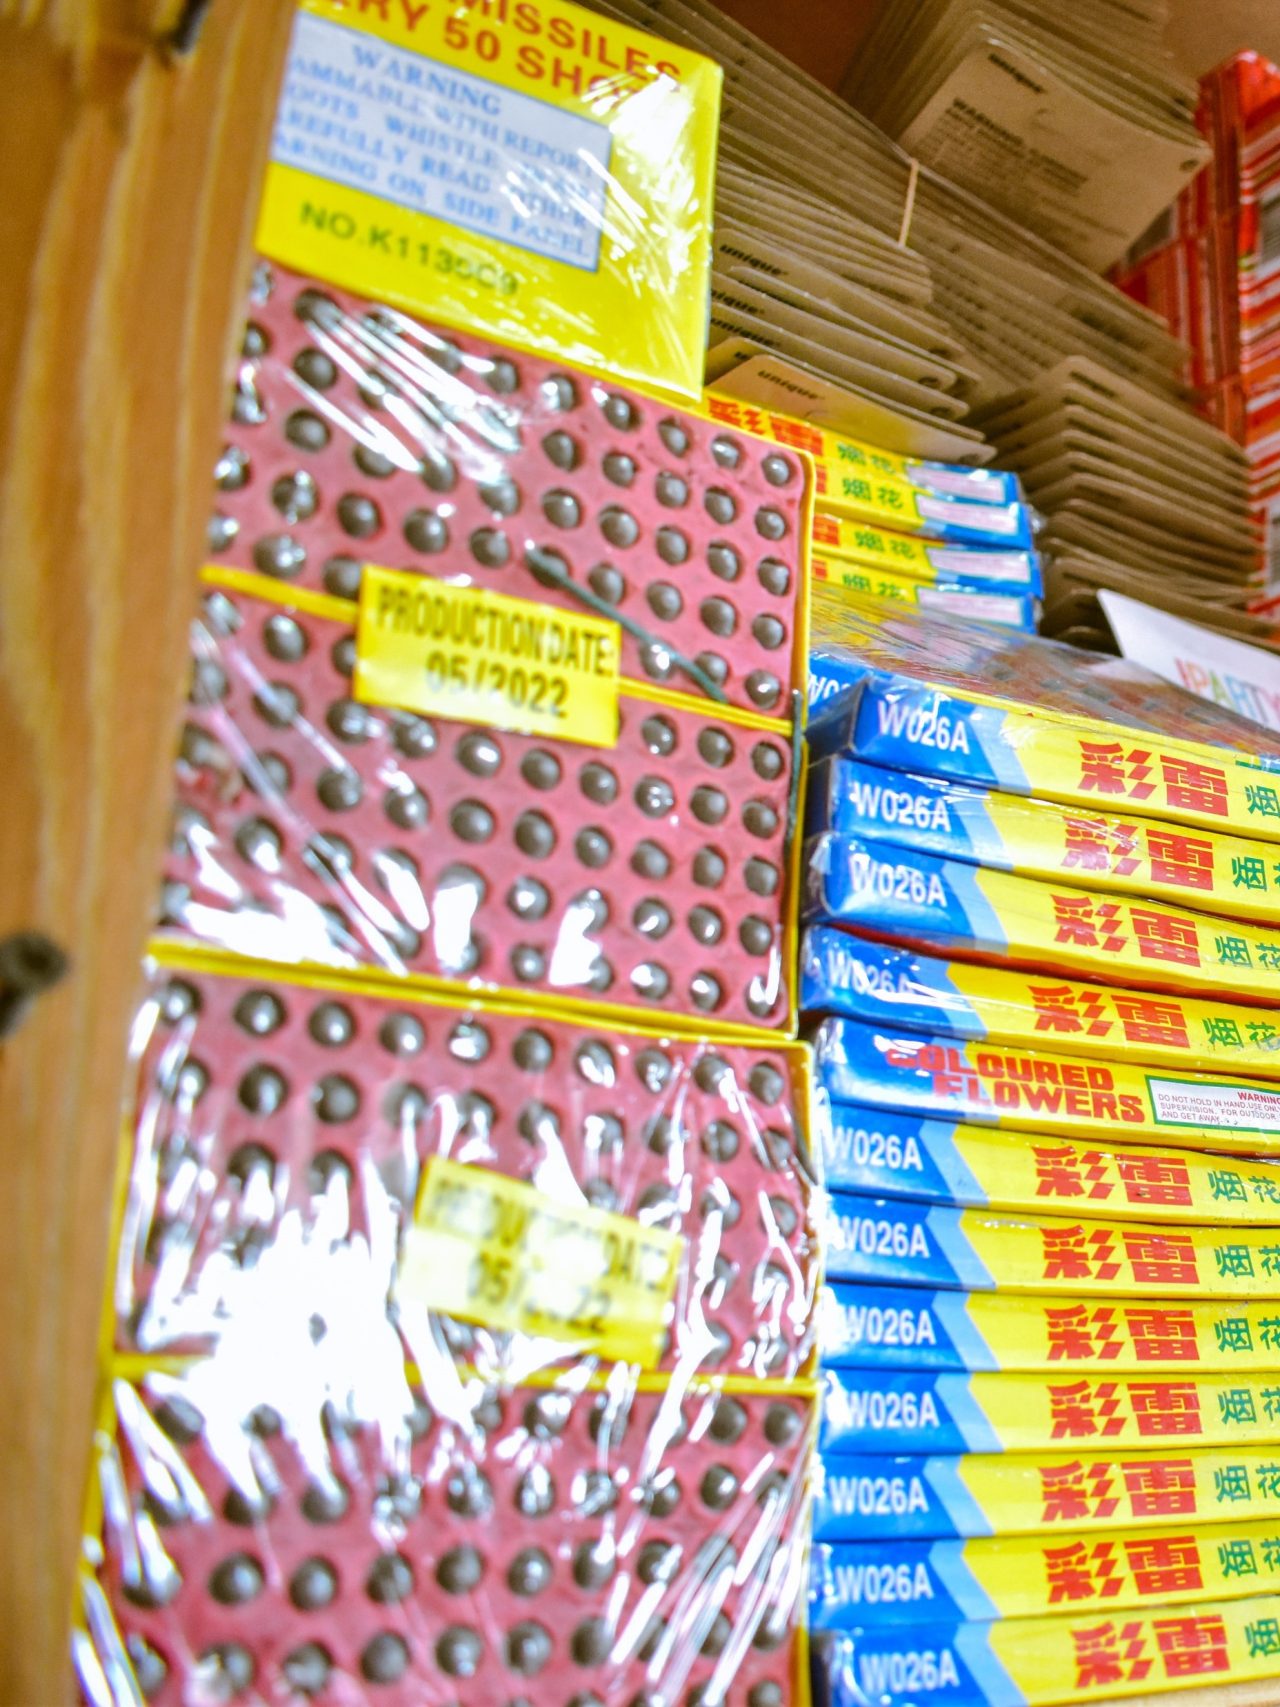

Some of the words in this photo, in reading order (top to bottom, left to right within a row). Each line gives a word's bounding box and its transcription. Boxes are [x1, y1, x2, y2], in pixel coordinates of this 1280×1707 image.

[443, 15, 501, 62] 50
[352, 44, 500, 115] WARNING
[757, 370, 819, 400] unique
[378, 585, 542, 662] PRODUCTION
[547, 624, 614, 677] DATE
[426, 651, 568, 719] 05/2022
[878, 699, 970, 755] W026A
[852, 781, 951, 832] W026A
[1078, 740, 1229, 817] 彩雷
[849, 852, 948, 908] W026A
[1061, 815, 1214, 891] 彩雷
[1051, 894, 1201, 967] 彩雷
[1027, 985, 1191, 1049] 彩雷
[932, 1073, 1145, 1124] FLOWERS
[1162, 1110, 1179, 1119] AND
[1180, 1112, 1196, 1120] GET
[1171, 1095, 1188, 1103] NOT
[1190, 1097, 1212, 1106] HOLD
[1221, 1108, 1238, 1116] FOR
[1239, 1109, 1277, 1120] OUTDOOR
[830, 1125, 924, 1172] W026A
[1030, 1145, 1193, 1207] 彩雷
[838, 1214, 931, 1259] W026A
[1039, 1224, 1200, 1284] 彩雷
[844, 1303, 937, 1346] W026A
[1044, 1304, 1200, 1361] 彩雷
[847, 1390, 940, 1429] W026A
[1046, 1380, 1203, 1440] 彩雷
[829, 1476, 930, 1515] W026A
[1038, 1459, 1197, 1522] 彩雷
[834, 1561, 934, 1605] W026A
[1042, 1535, 1204, 1604] 彩雷
[859, 1648, 961, 1693] W026A
[1071, 1614, 1231, 1689] 彩雷
